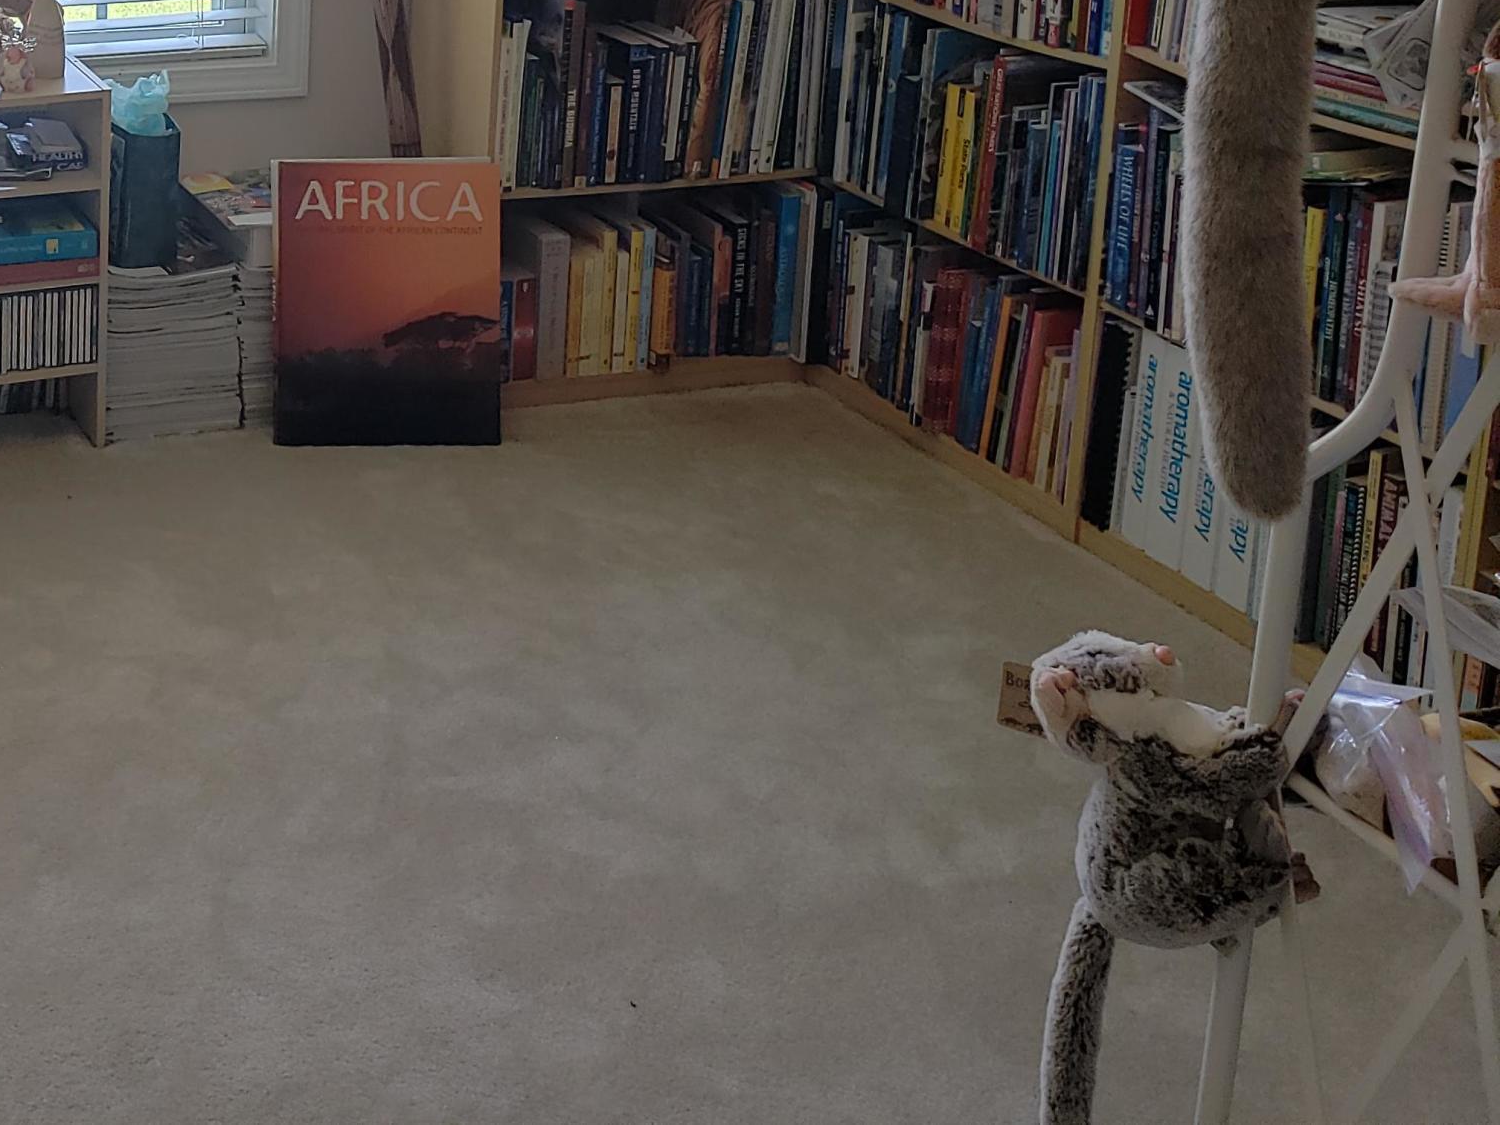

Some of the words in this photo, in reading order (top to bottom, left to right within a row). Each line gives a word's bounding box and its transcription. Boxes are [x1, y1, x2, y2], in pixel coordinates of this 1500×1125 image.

[567, 88, 577, 107] THE
[628, 91, 640, 131] MOUNTAIN
[990, 91, 1002, 128] NATIONAL
[564, 110, 576, 148] BUDDHA
[961, 138, 971, 163] State
[958, 164, 967, 190] Parks
[1121, 155, 1135, 202] WHEELS
[295, 180, 483, 222] AFRICA
[1119, 206, 1132, 222] OF
[737, 227, 747, 251] SIGNS
[1116, 226, 1129, 251] LIFE
[734, 263, 745, 277] THE
[735, 252, 746, 261] IN
[733, 277, 745, 293] SKY
[1324, 280, 1338, 342] HOMEOPATHY
[1353, 279, 1367, 337] SHIATSU
[1131, 354, 1159, 503] aromatherapy
[1160, 371, 1194, 523] aromatherapy
